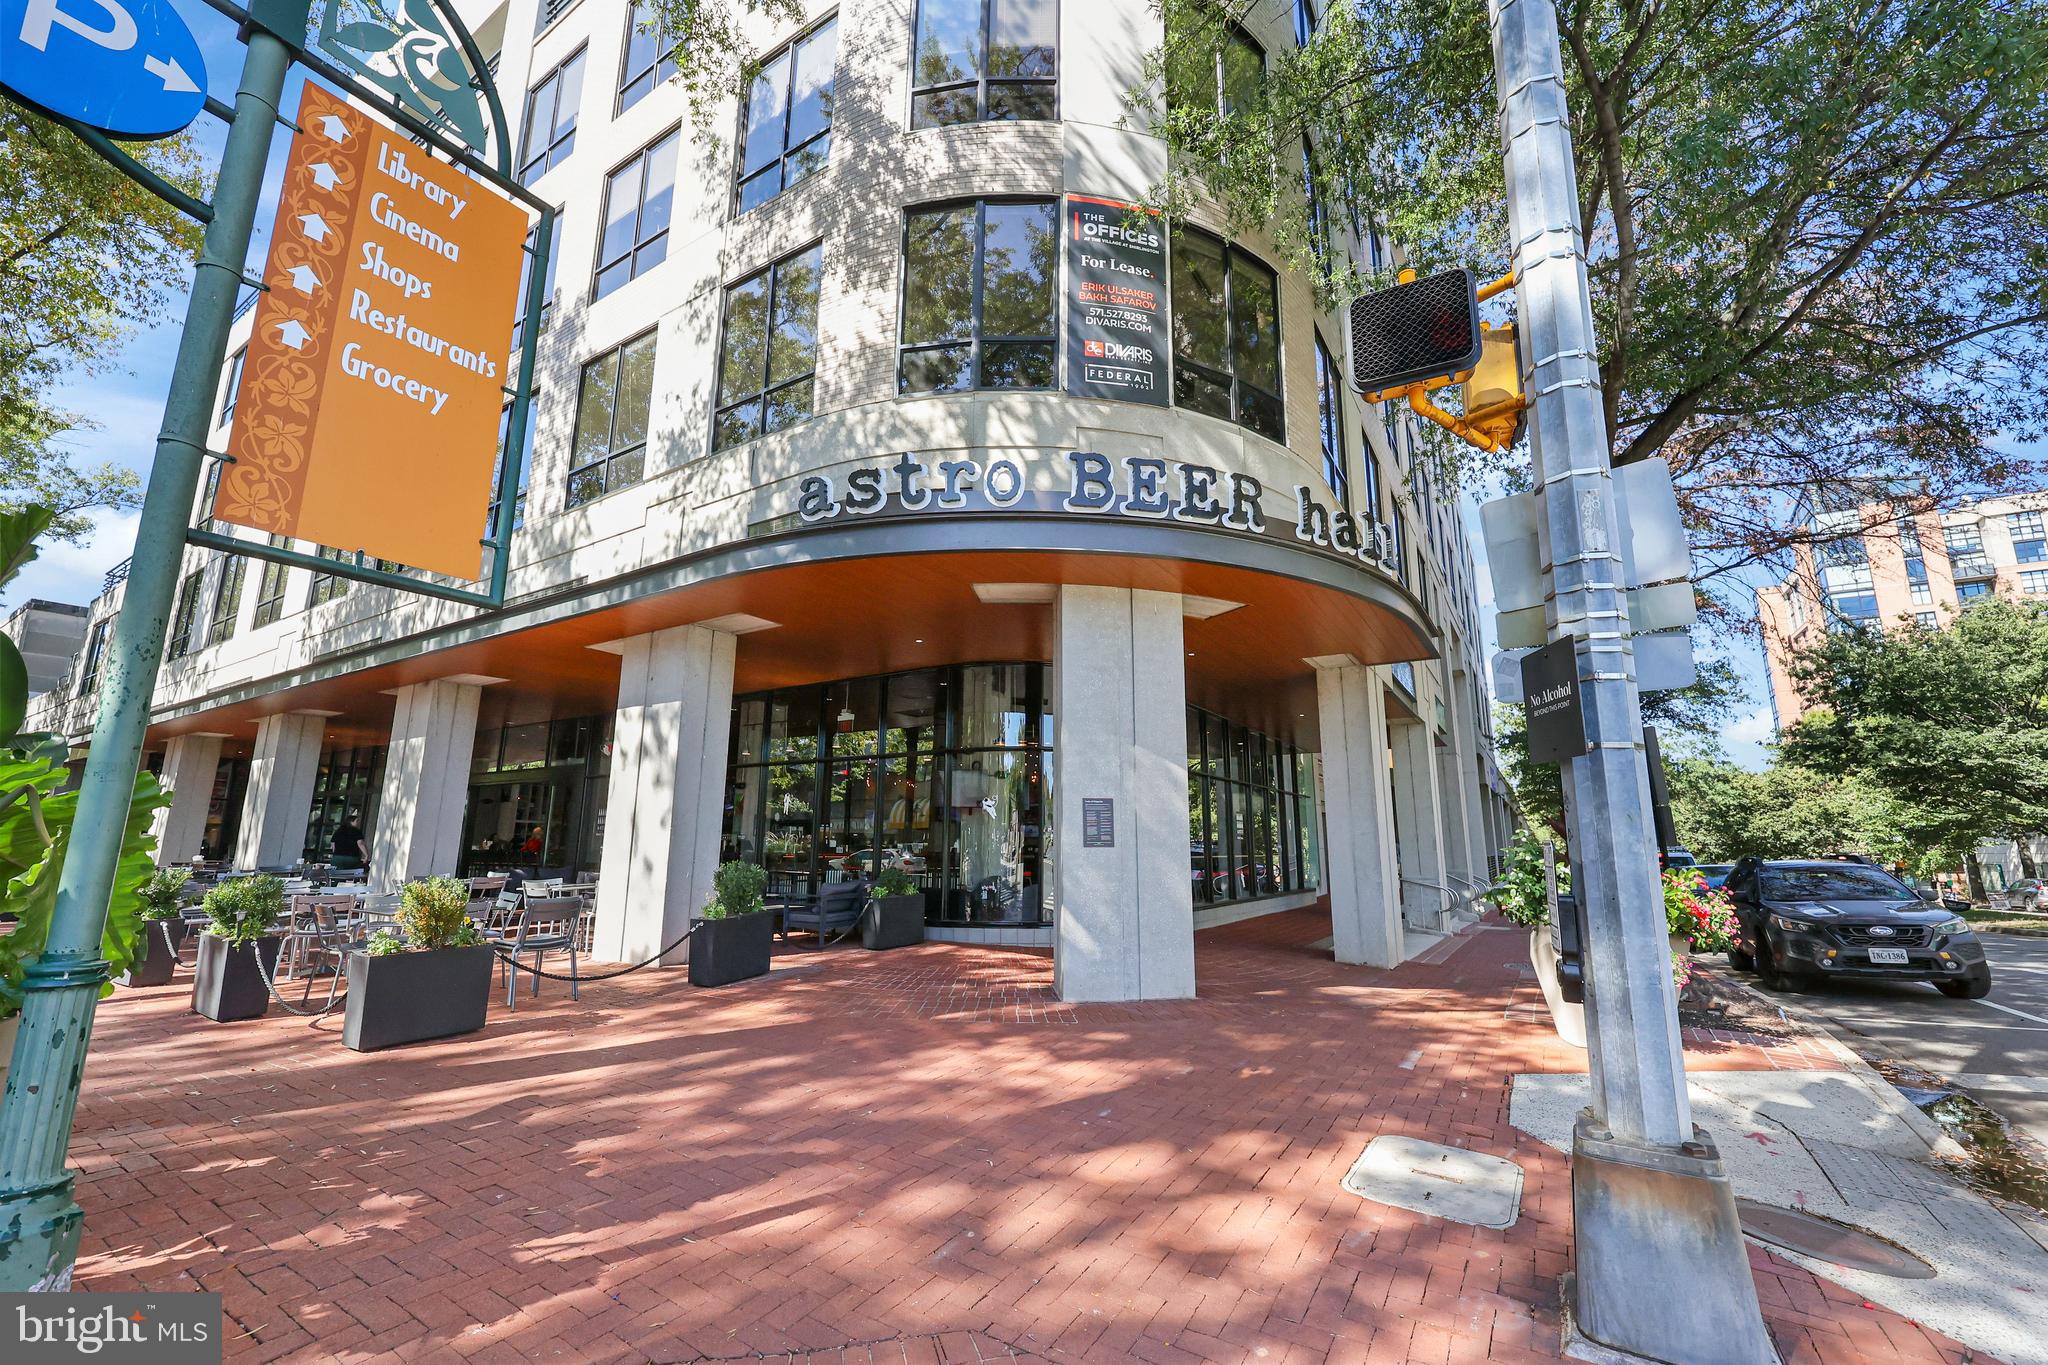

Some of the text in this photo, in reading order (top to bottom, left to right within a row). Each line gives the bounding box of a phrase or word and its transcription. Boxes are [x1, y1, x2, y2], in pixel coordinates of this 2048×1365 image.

[377, 141, 467, 220] Library
[370, 191, 460, 262] Cinema
[1083, 212, 1105, 222] THE
[1083, 222, 1159, 248] OFFICES
[1102, 238, 1122, 247] VILLAGE
[360, 241, 433, 299] Shops
[1081, 254, 1155, 279] For Lease.
[1079, 291, 1157, 311] BAKH SAFAROV
[1081, 282, 1154, 301] ERIK ULSAKER
[1085, 316, 1152, 333] DIVARIS.COM
[1089, 307, 1148, 323] 571.527.8293
[350, 288, 496, 378] Restaurants
[1105, 342, 1153, 362] DIVARIS
[341, 342, 449, 416] Grocery
[1089, 369, 1150, 384] FEDERAL
[800, 451, 1399, 576] astro BEER hall
[1530, 680, 1572, 708] No Alcohol
[1533, 706, 1550, 717] BEYOND
[1558, 700, 1570, 709] POINT
